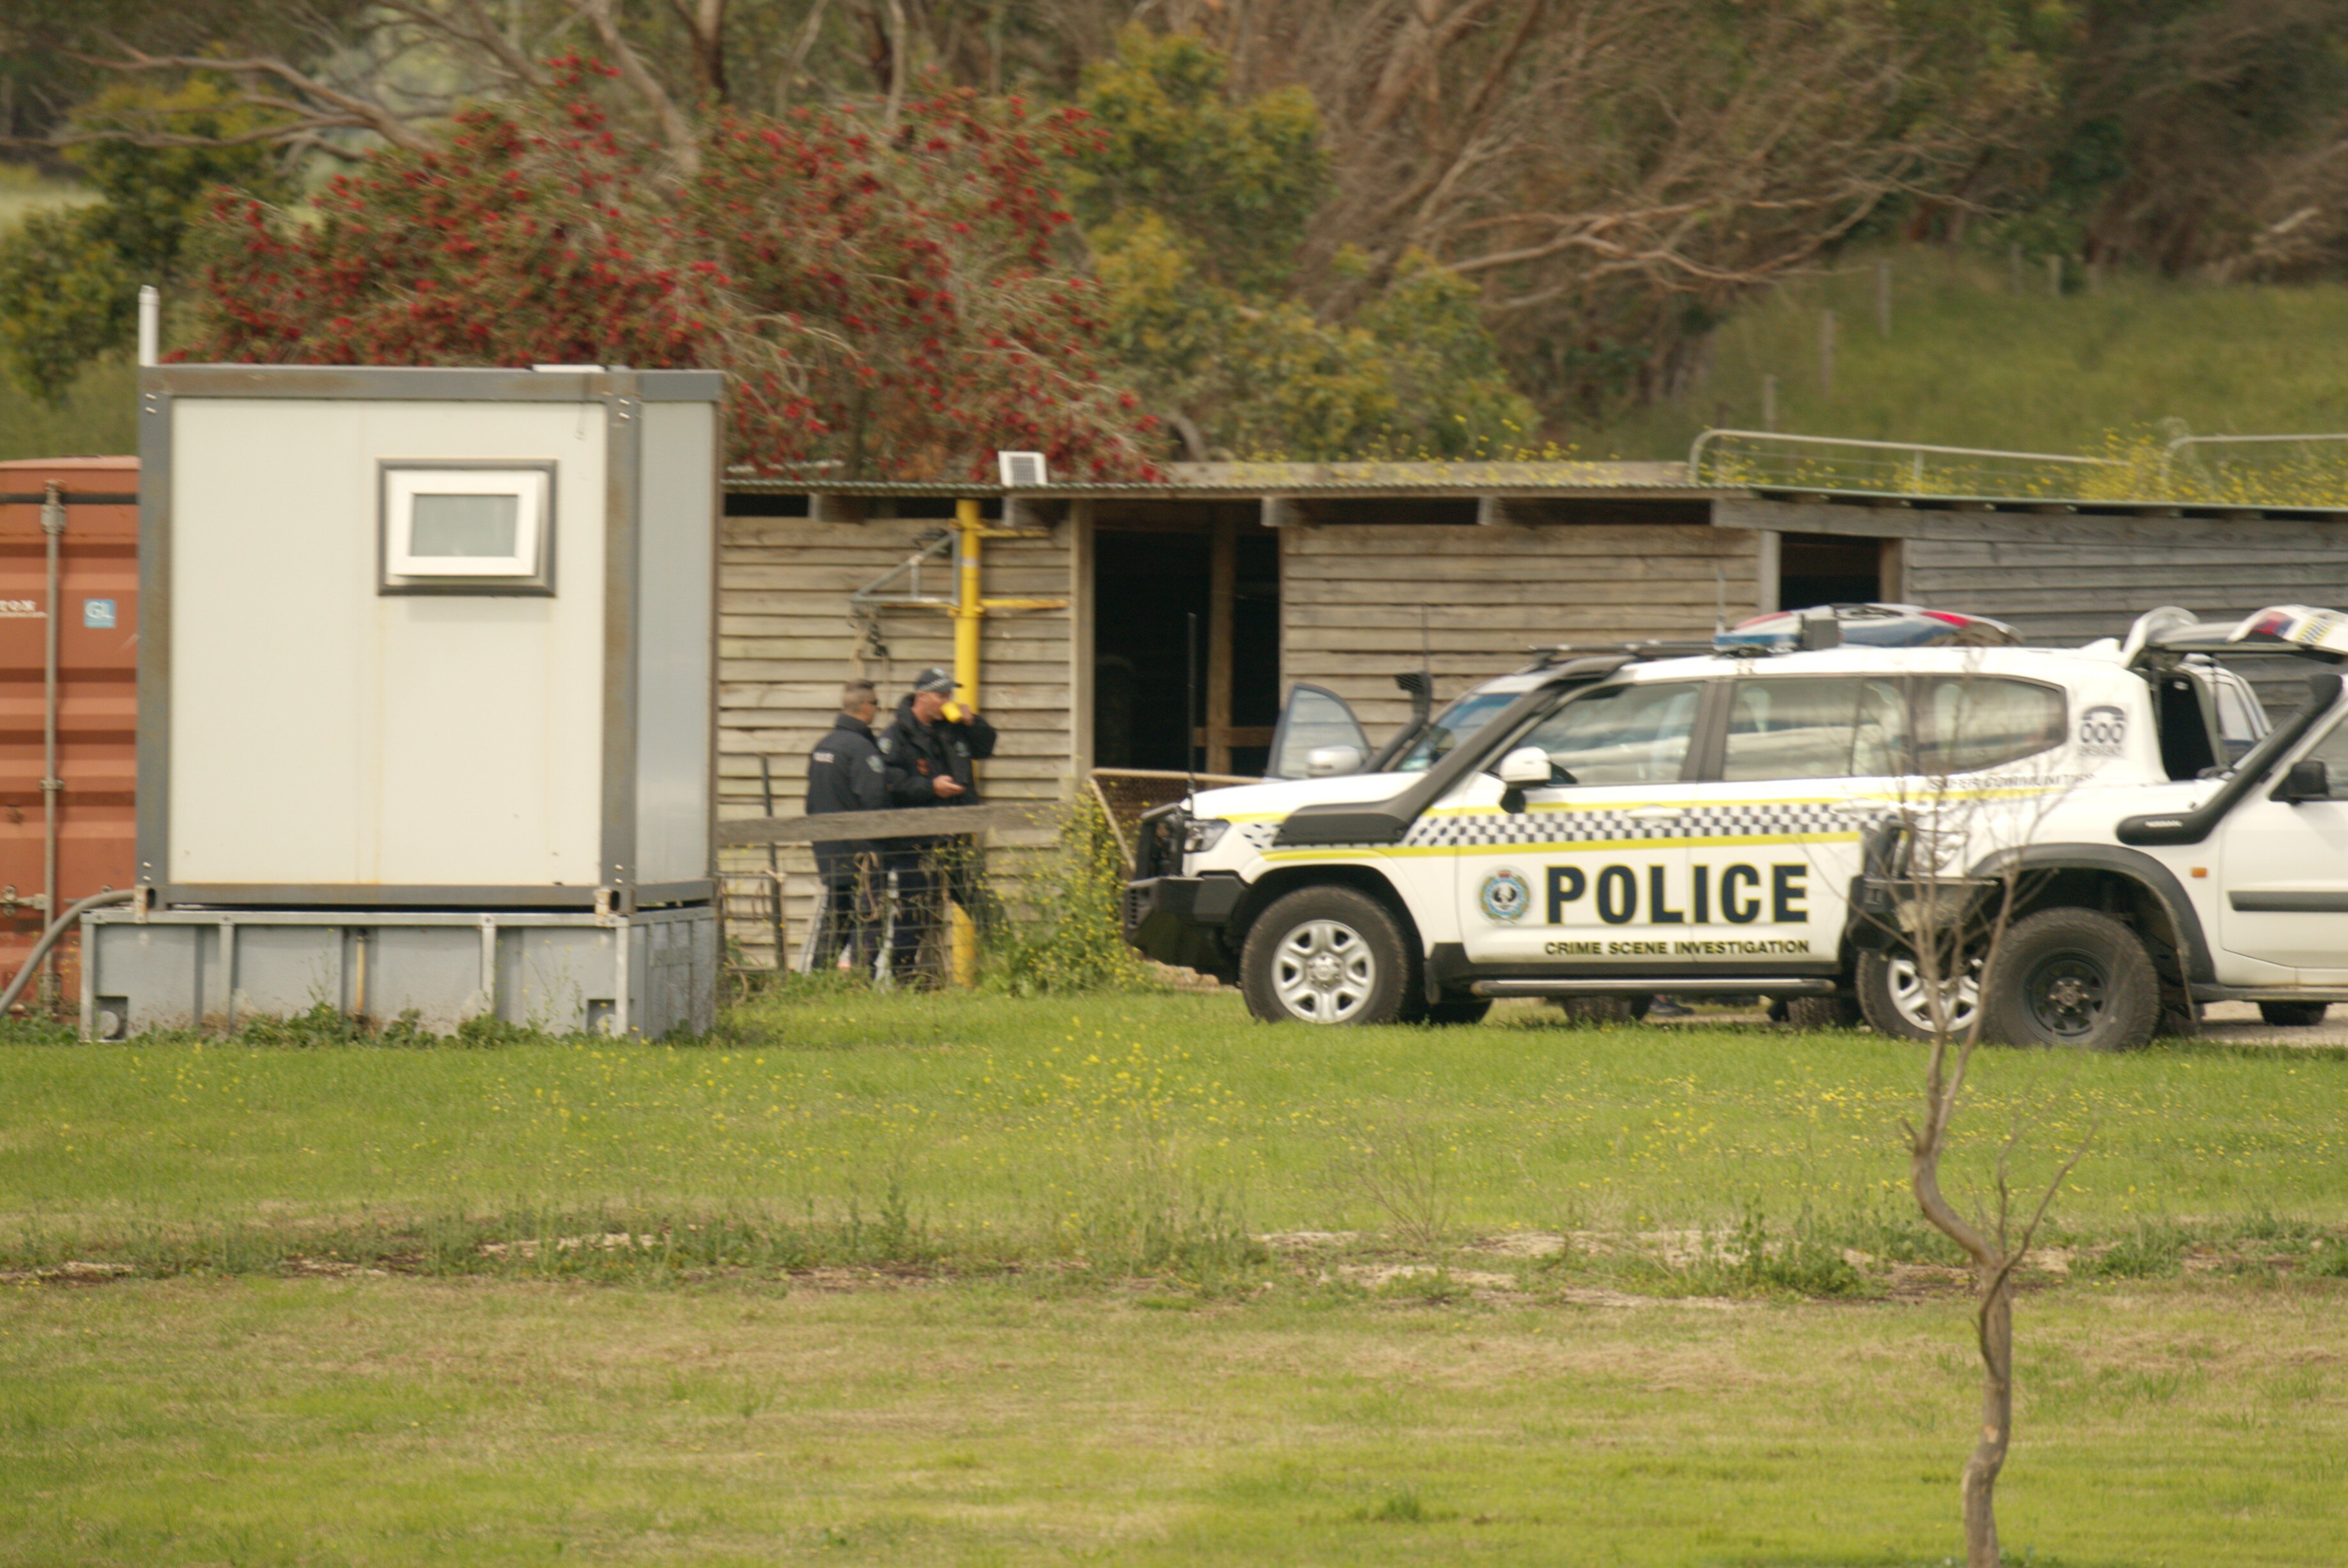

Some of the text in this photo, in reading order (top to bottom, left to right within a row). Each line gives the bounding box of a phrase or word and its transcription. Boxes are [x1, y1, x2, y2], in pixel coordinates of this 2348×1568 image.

[1545, 863, 1809, 925] POLICE
[1545, 940, 1809, 955] CRIME SCENE INVESTIGATION
